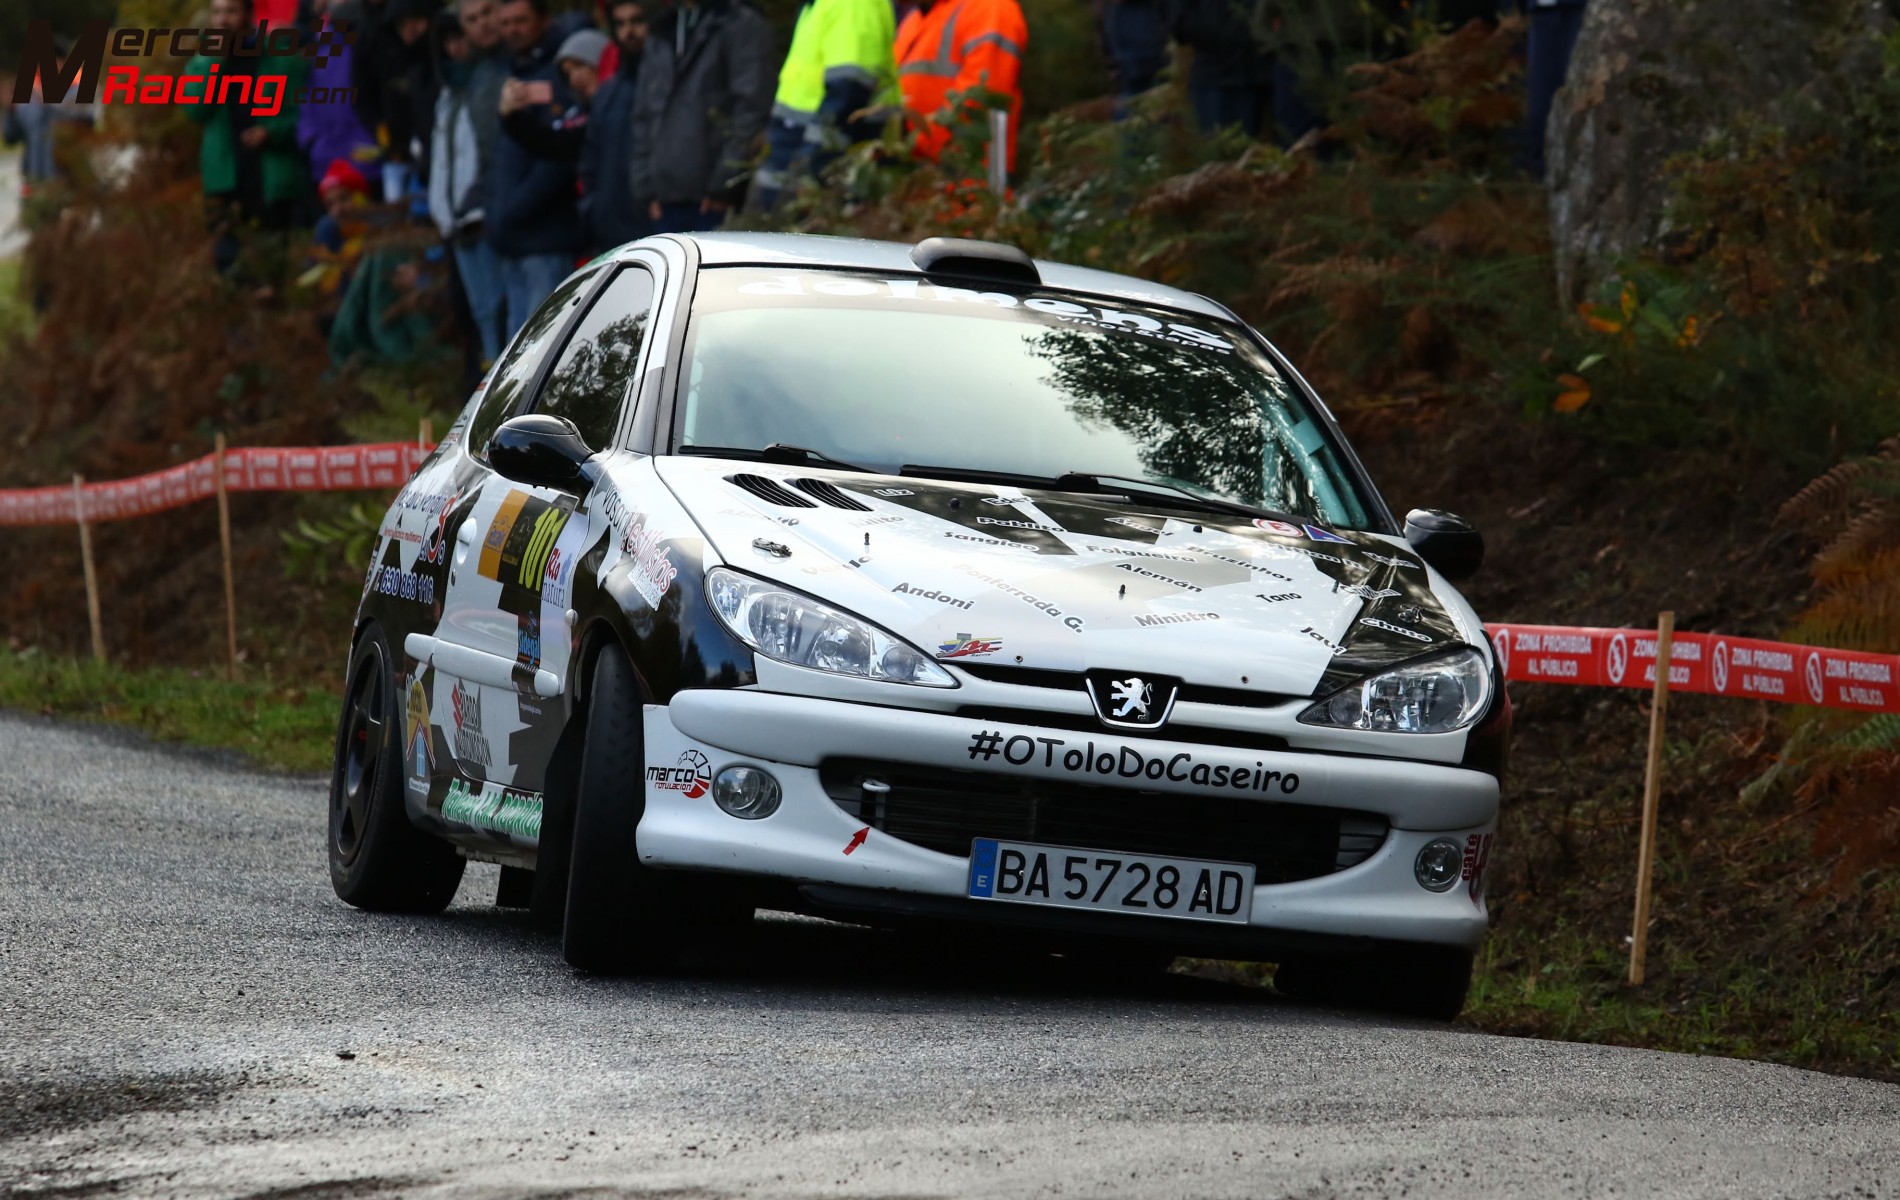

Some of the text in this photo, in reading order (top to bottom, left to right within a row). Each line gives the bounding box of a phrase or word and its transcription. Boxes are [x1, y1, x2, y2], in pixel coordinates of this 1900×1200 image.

[737, 276, 1235, 350] dolmens
[978, 517, 1065, 533] Pablito
[518, 506, 568, 592] 101
[1086, 545, 1197, 563] Folgueira
[380, 567, 401, 596] 630
[400, 572, 418, 601] 868
[418, 574, 434, 605] 116
[1116, 562, 1203, 593] Alemán
[891, 582, 975, 610] Andoni
[953, 563, 1084, 634] Ponferrada G.
[1256, 592, 1303, 604] Tano
[1133, 612, 1221, 627] Ministro
[1515, 634, 1592, 654] ZONA PROHIBIDA
[1528, 658, 1540, 674] AL
[1732, 647, 1793, 672] ZONA PROHIBIDA
[1826, 658, 1891, 684] ZONA PROHIBIDA
[1742, 674, 1753, 691] AL
[1839, 685, 1851, 702] AL
[968, 730, 1300, 795] #OToloDoCaseiro
[976, 848, 1245, 916] E BA 5728 AD
